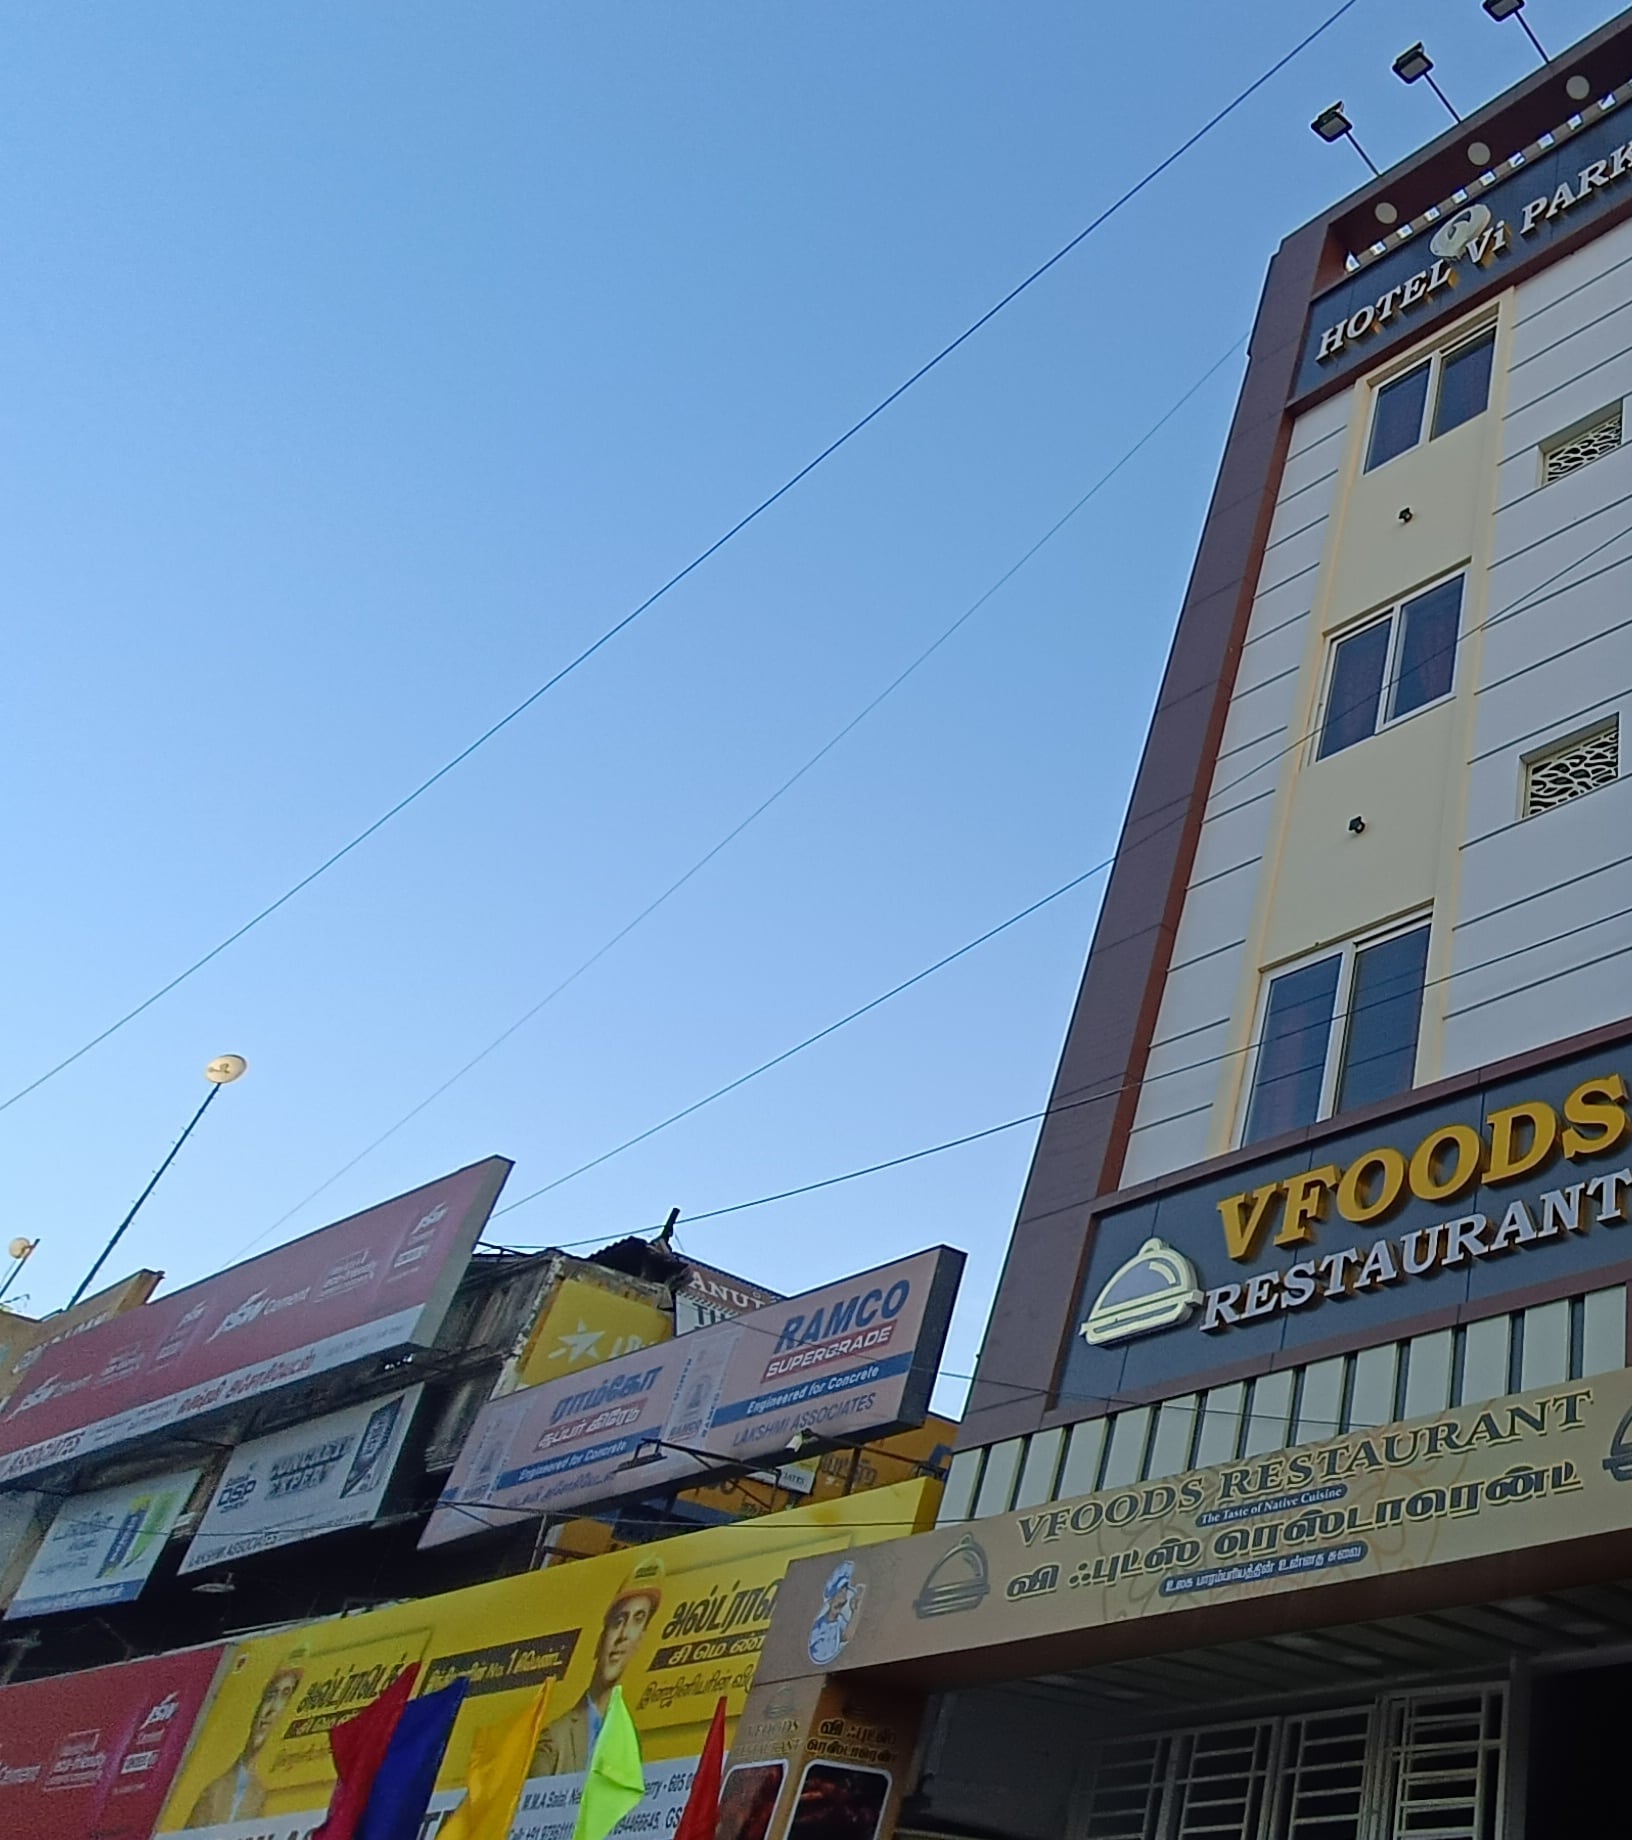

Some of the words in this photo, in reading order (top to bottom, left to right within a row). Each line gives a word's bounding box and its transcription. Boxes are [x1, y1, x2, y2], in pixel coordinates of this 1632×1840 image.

[1316, 259, 1452, 361] HOTEL
[1466, 221, 1507, 264] Vi
[1217, 1074, 1630, 1260] VFOODS
[773, 1279, 911, 1355] RAMCO
[765, 1325, 893, 1379] SUPERGRADE
[550, 1366, 662, 1426] ராம்கோ
[747, 1387, 806, 1416] Engineered
[808, 1381, 827, 1401] for
[828, 1366, 880, 1391] Concrete
[732, 1418, 791, 1447] LAKSHMI
[791, 1393, 877, 1432] ASSOCIATES
[1020, 1477, 1203, 1543] VFOODS
[1220, 1391, 1592, 1500] RESTAURANT
[1201, 1514, 1221, 1525] The
[1223, 1508, 1249, 1520] Taste
[1251, 1502, 1264, 1514] of
[1264, 1497, 1299, 1512] Native
[1301, 1488, 1342, 1504] Cuisine
[1007, 1563, 1059, 1599] வி
